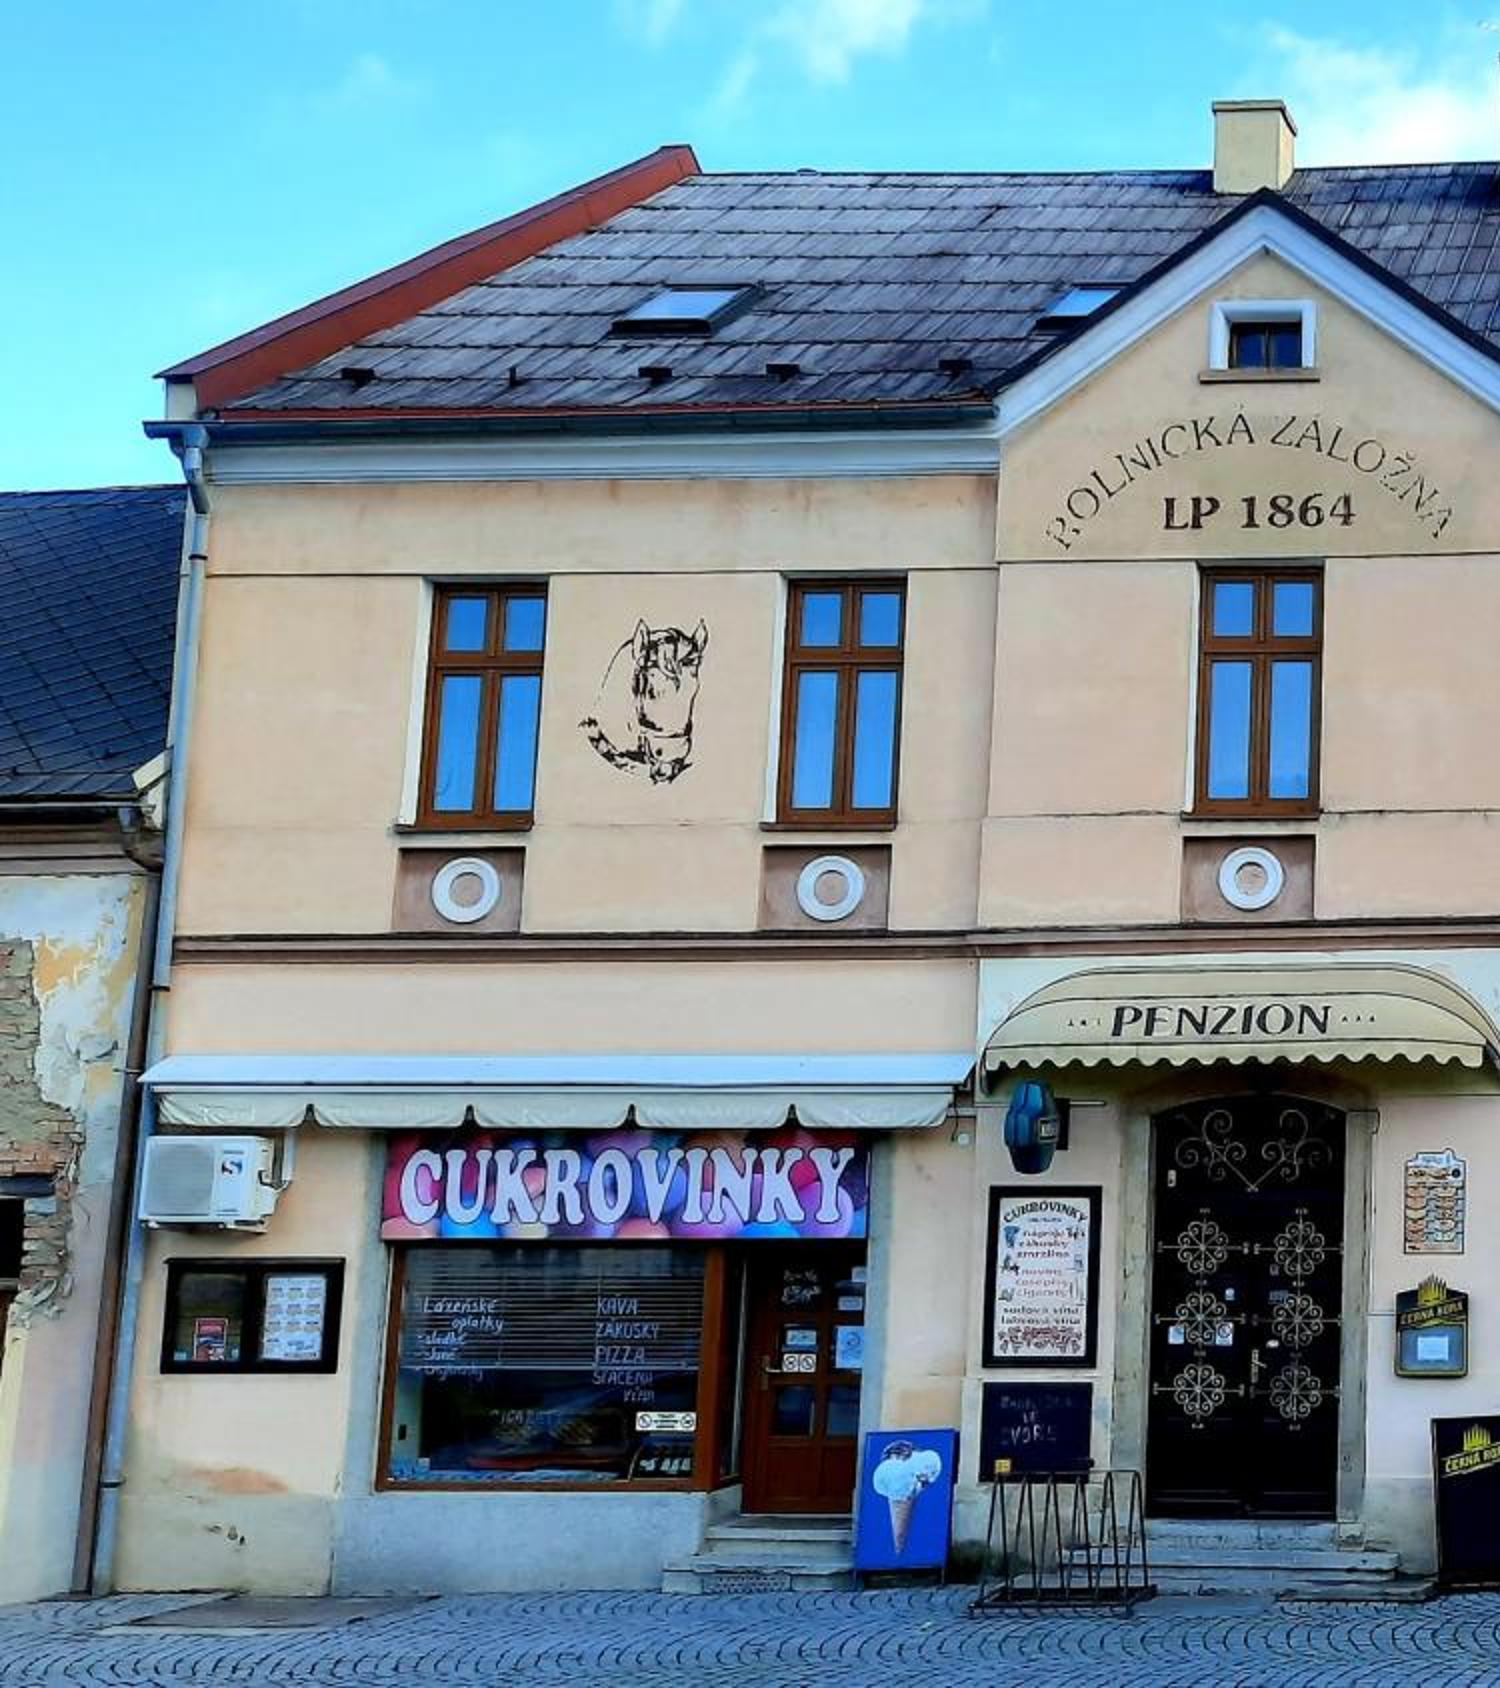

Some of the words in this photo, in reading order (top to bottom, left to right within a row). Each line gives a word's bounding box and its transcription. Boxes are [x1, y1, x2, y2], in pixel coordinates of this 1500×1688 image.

[1162, 496, 1221, 530] LP
[1240, 491, 1358, 530] 1864
[1111, 1004, 1333, 1038] PENZION
[400, 1146, 856, 1225] CUKROVINKY
[1003, 1201, 1088, 1222] CUKROVINKY
